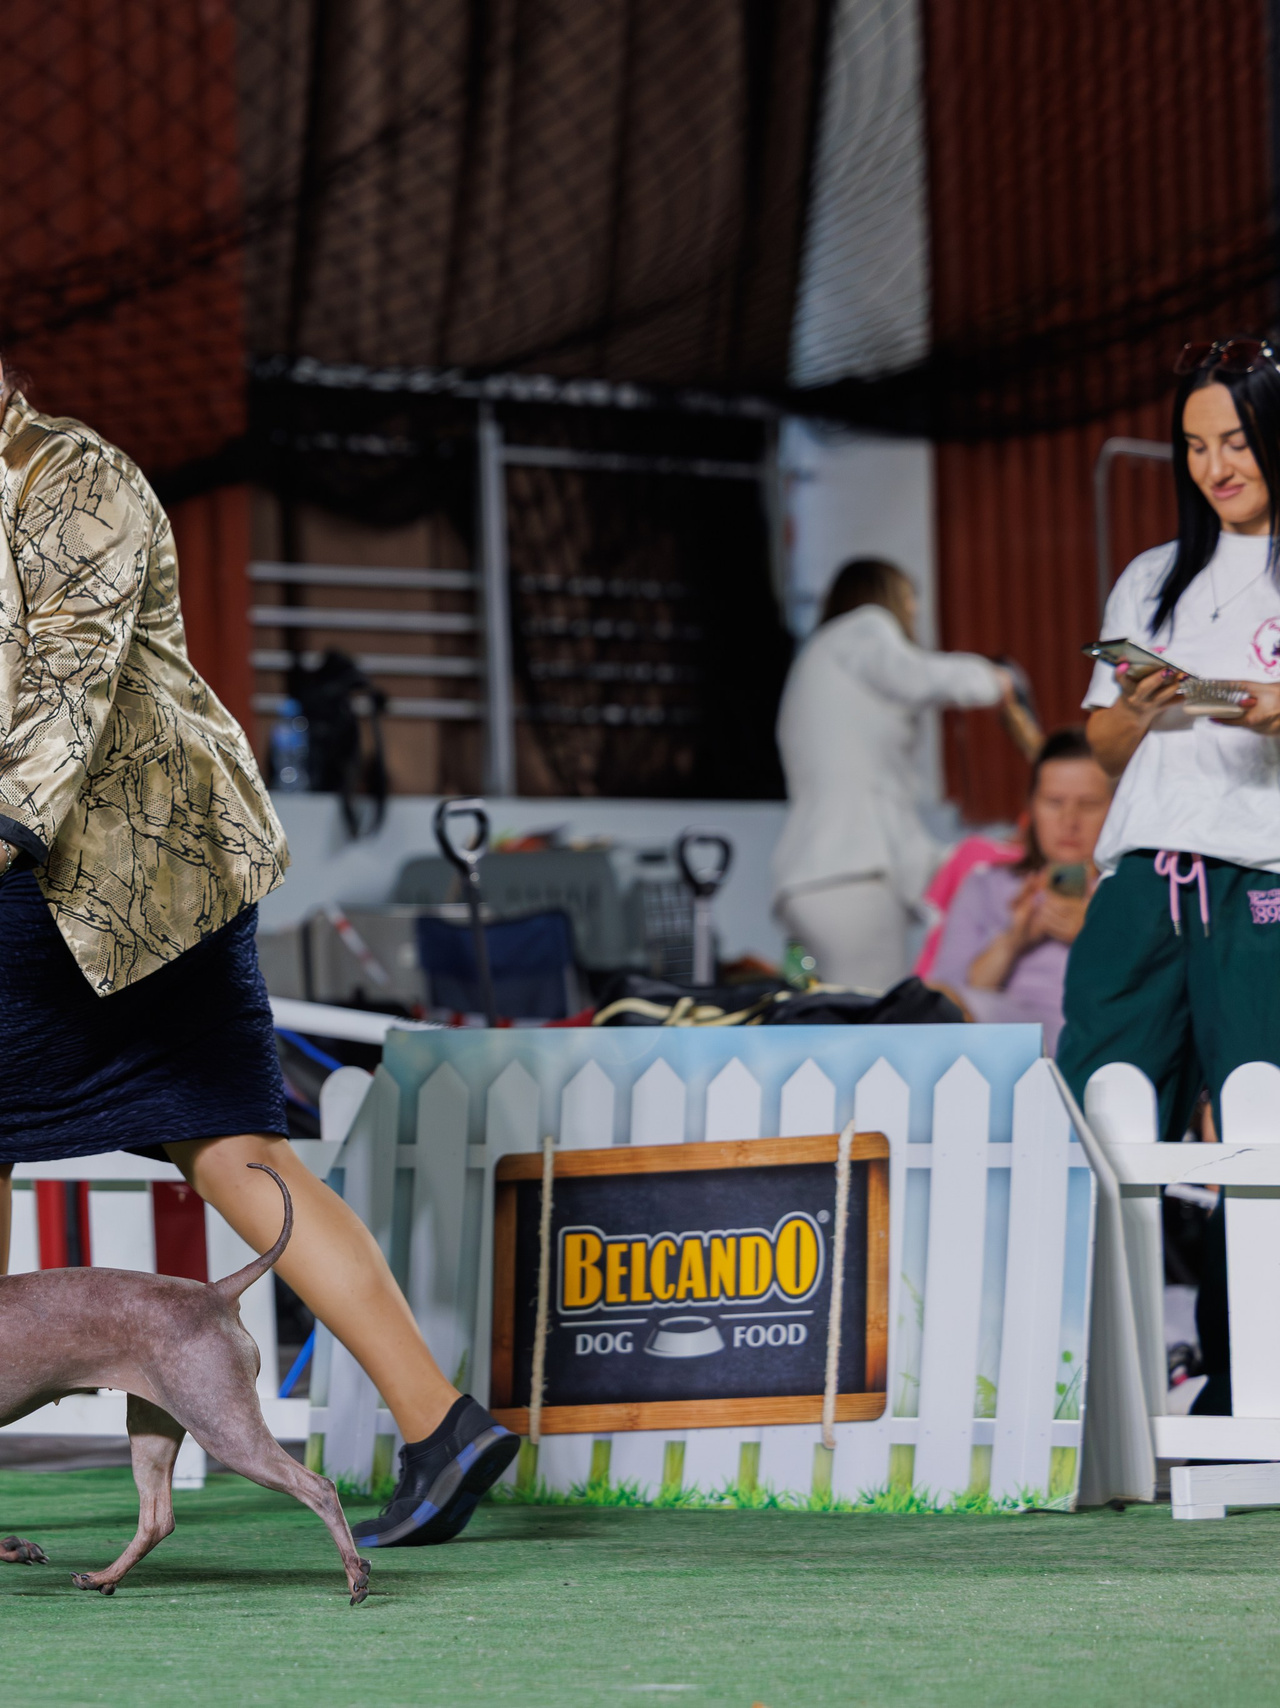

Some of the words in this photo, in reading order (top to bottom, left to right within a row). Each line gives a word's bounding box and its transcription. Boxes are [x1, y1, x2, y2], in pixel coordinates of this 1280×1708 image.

[1250, 905, 1280, 924] 189
[576, 1331, 633, 1355] DOG
[733, 1323, 807, 1348] FOOD
